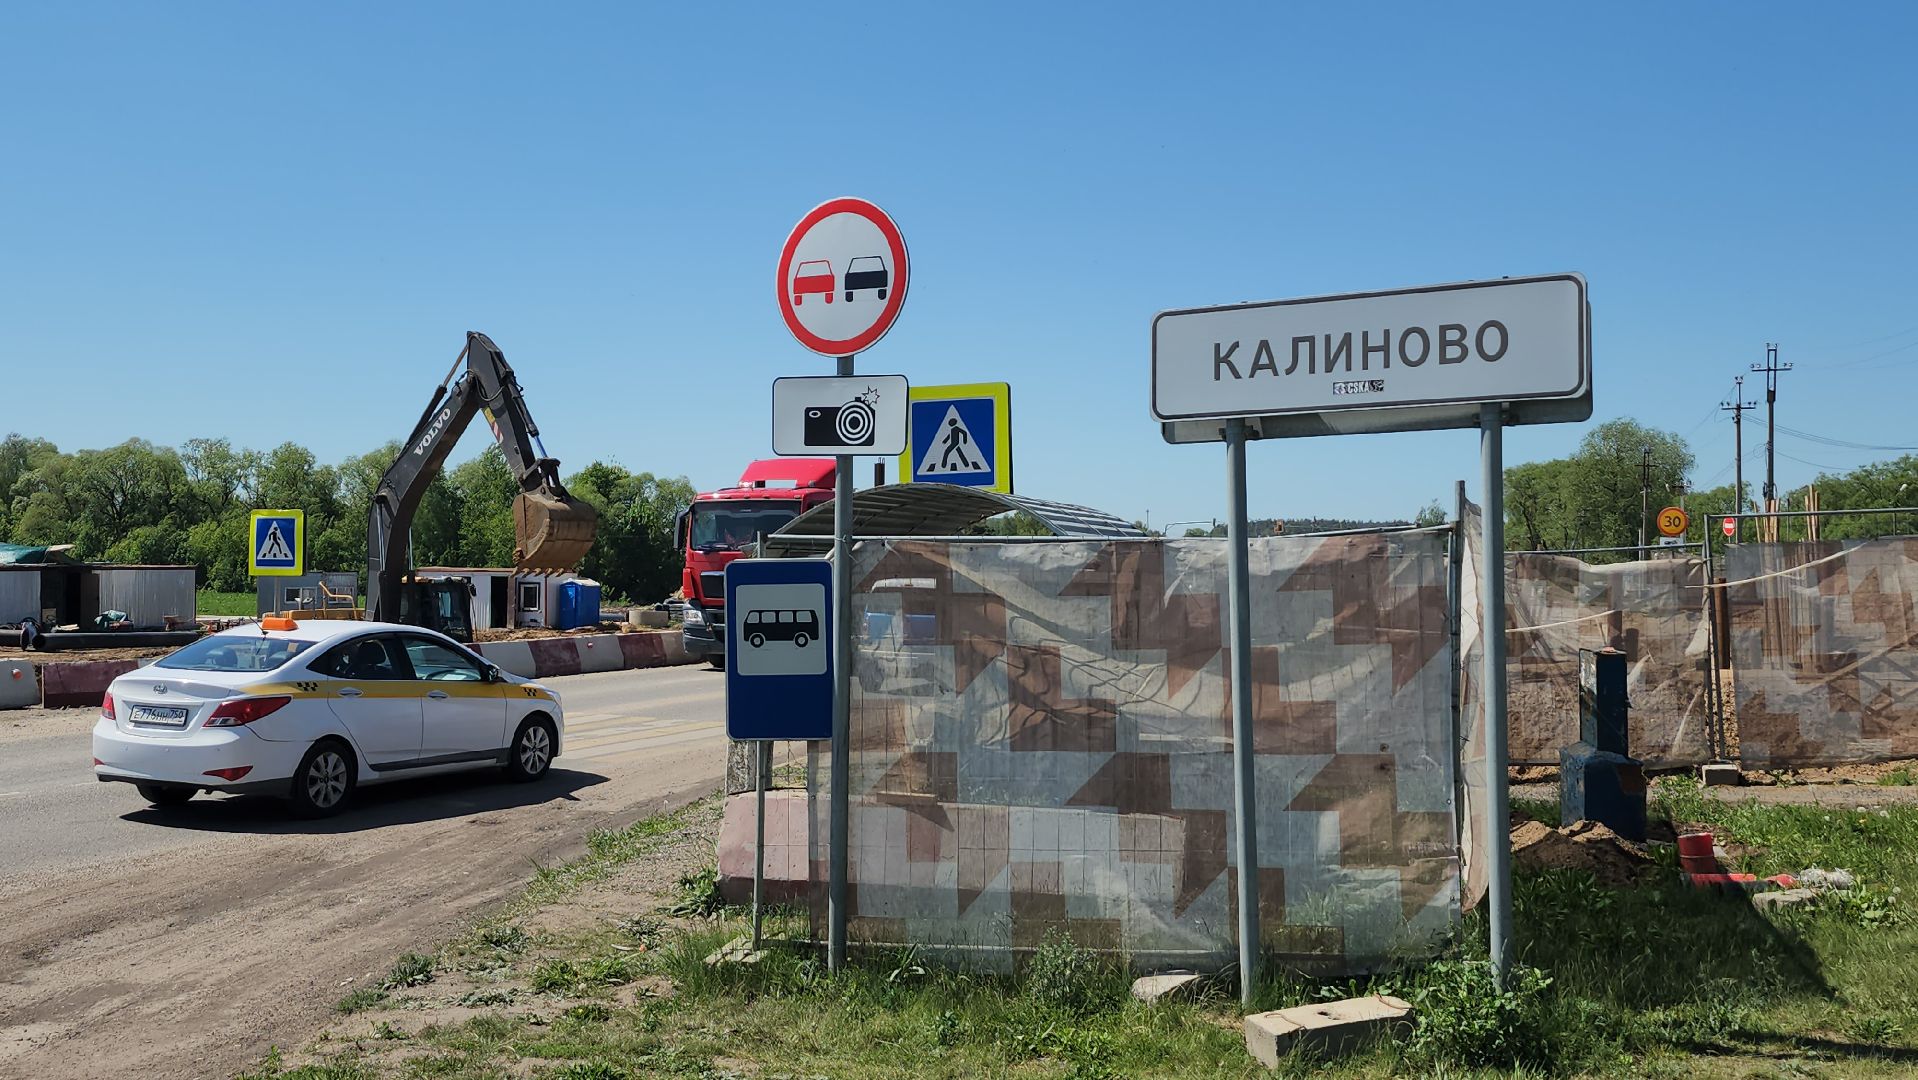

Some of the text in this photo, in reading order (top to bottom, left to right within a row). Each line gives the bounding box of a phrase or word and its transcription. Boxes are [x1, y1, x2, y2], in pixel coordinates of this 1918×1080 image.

[1213, 319, 1509, 381] КАЛИНОВО
[1347, 381, 1370, 394] CSKA
[413, 408, 451, 456] VOLVO
[1664, 515, 1681, 528] 30
